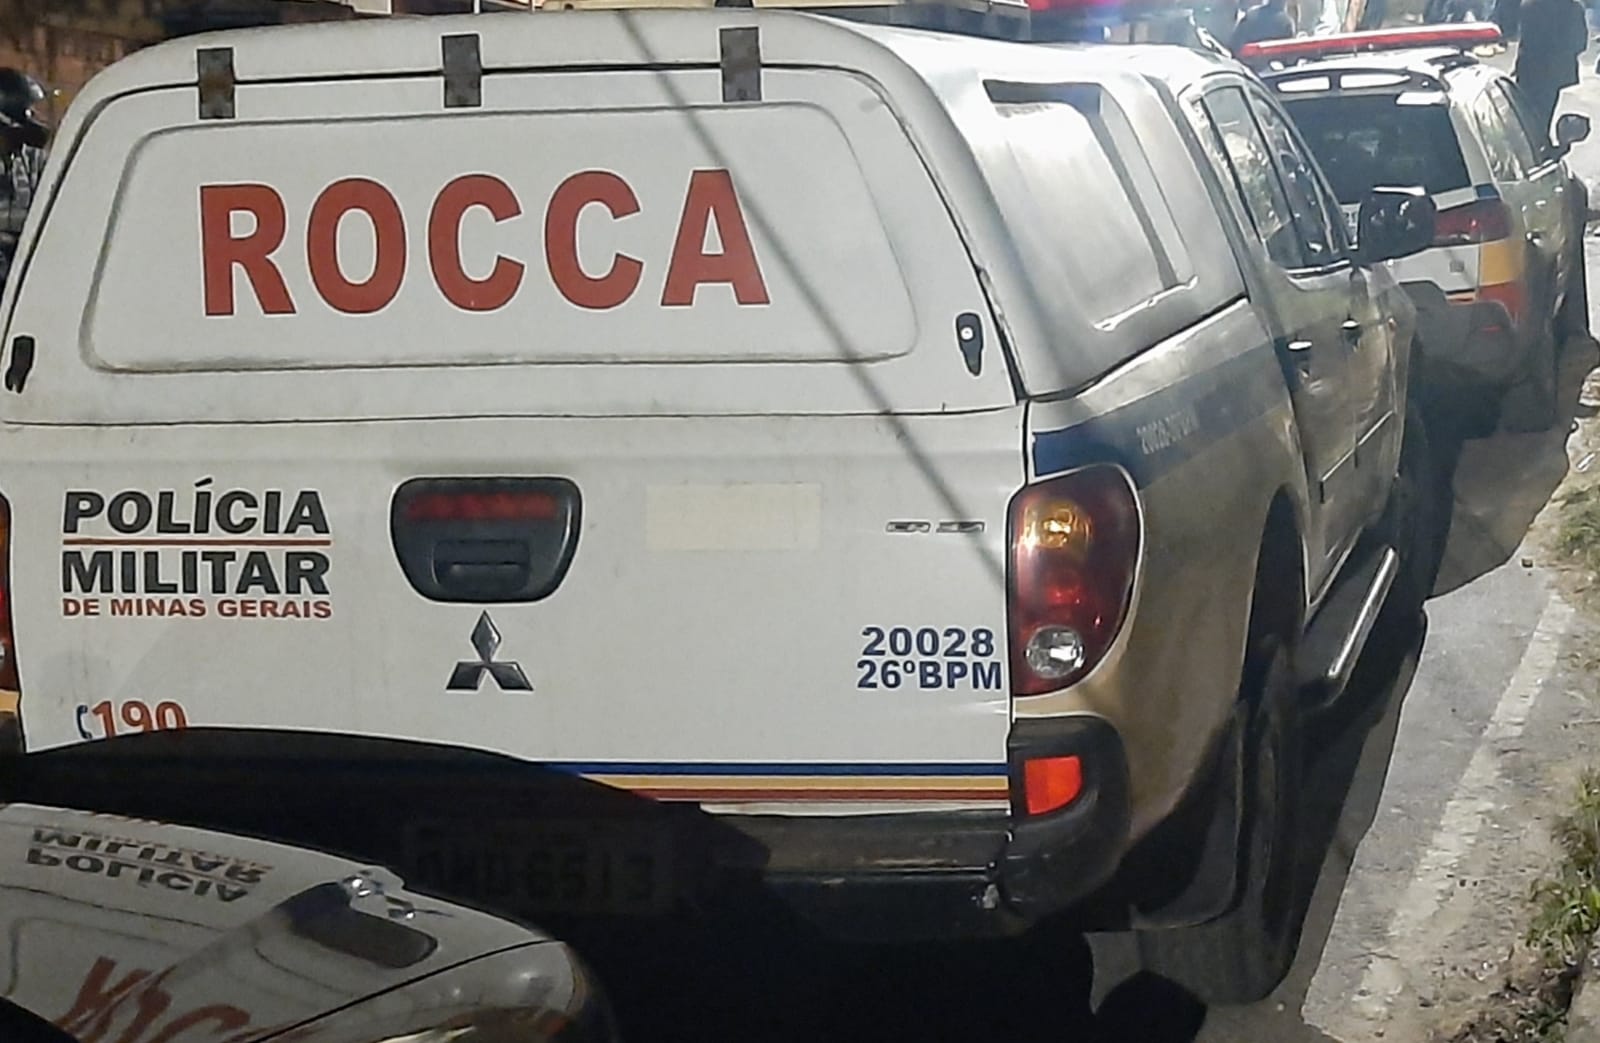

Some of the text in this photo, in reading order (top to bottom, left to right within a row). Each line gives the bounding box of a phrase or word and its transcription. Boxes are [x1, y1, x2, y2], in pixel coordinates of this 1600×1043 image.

[199, 168, 771, 317] ROCCA
[63, 477, 331, 534] POLÍCIA
[62, 551, 331, 595] MILITAR
[63, 598, 331, 618] DE MINAS GERAIS
[861, 626, 995, 657] 20028
[92, 700, 188, 738] 190
